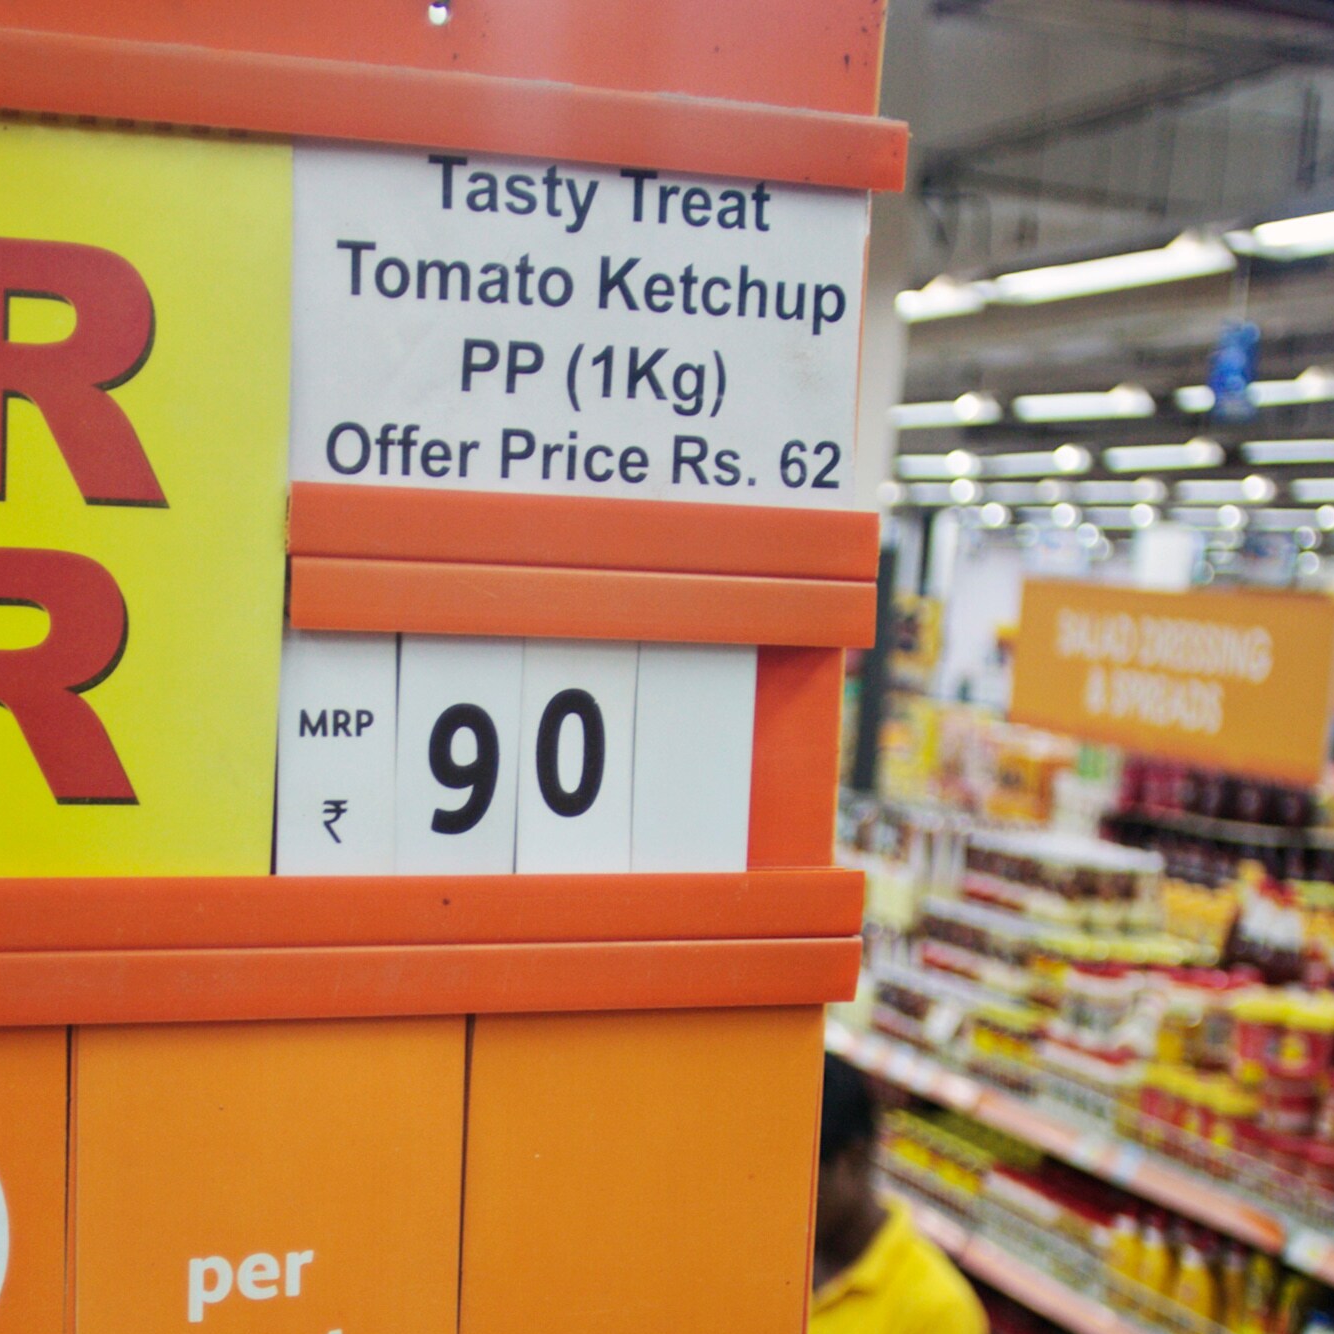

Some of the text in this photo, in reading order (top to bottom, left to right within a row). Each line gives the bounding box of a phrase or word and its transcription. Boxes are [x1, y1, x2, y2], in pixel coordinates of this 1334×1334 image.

[427, 154, 772, 233] Tasty Treat
[336, 240, 847, 335] Tomato Ketchup
[460, 338, 728, 417] PP (1Kg)
[325, 422, 842, 490] Offer Price Rs. 62
[298, 709, 375, 738] MRP
[428, 687, 606, 835] 90
[186, 1246, 314, 1325] per
